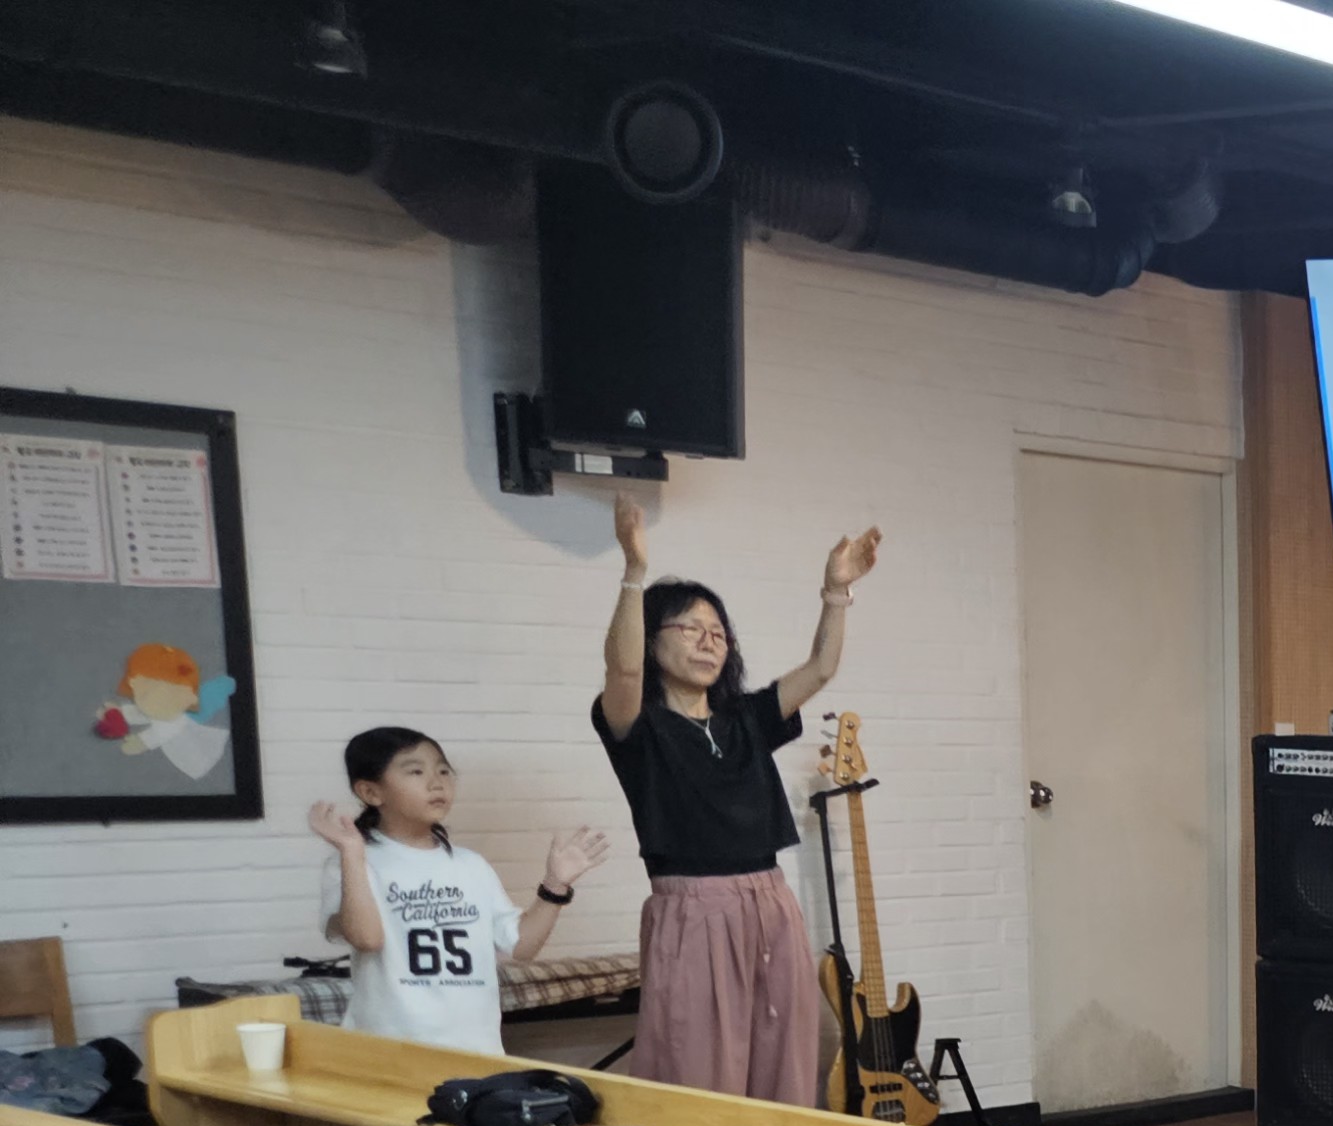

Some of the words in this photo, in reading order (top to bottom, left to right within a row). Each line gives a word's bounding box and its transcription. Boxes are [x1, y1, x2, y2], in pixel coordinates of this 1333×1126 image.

[386, 880, 464, 903] Southern
[397, 901, 480, 926] California
[407, 927, 473, 976] 65
